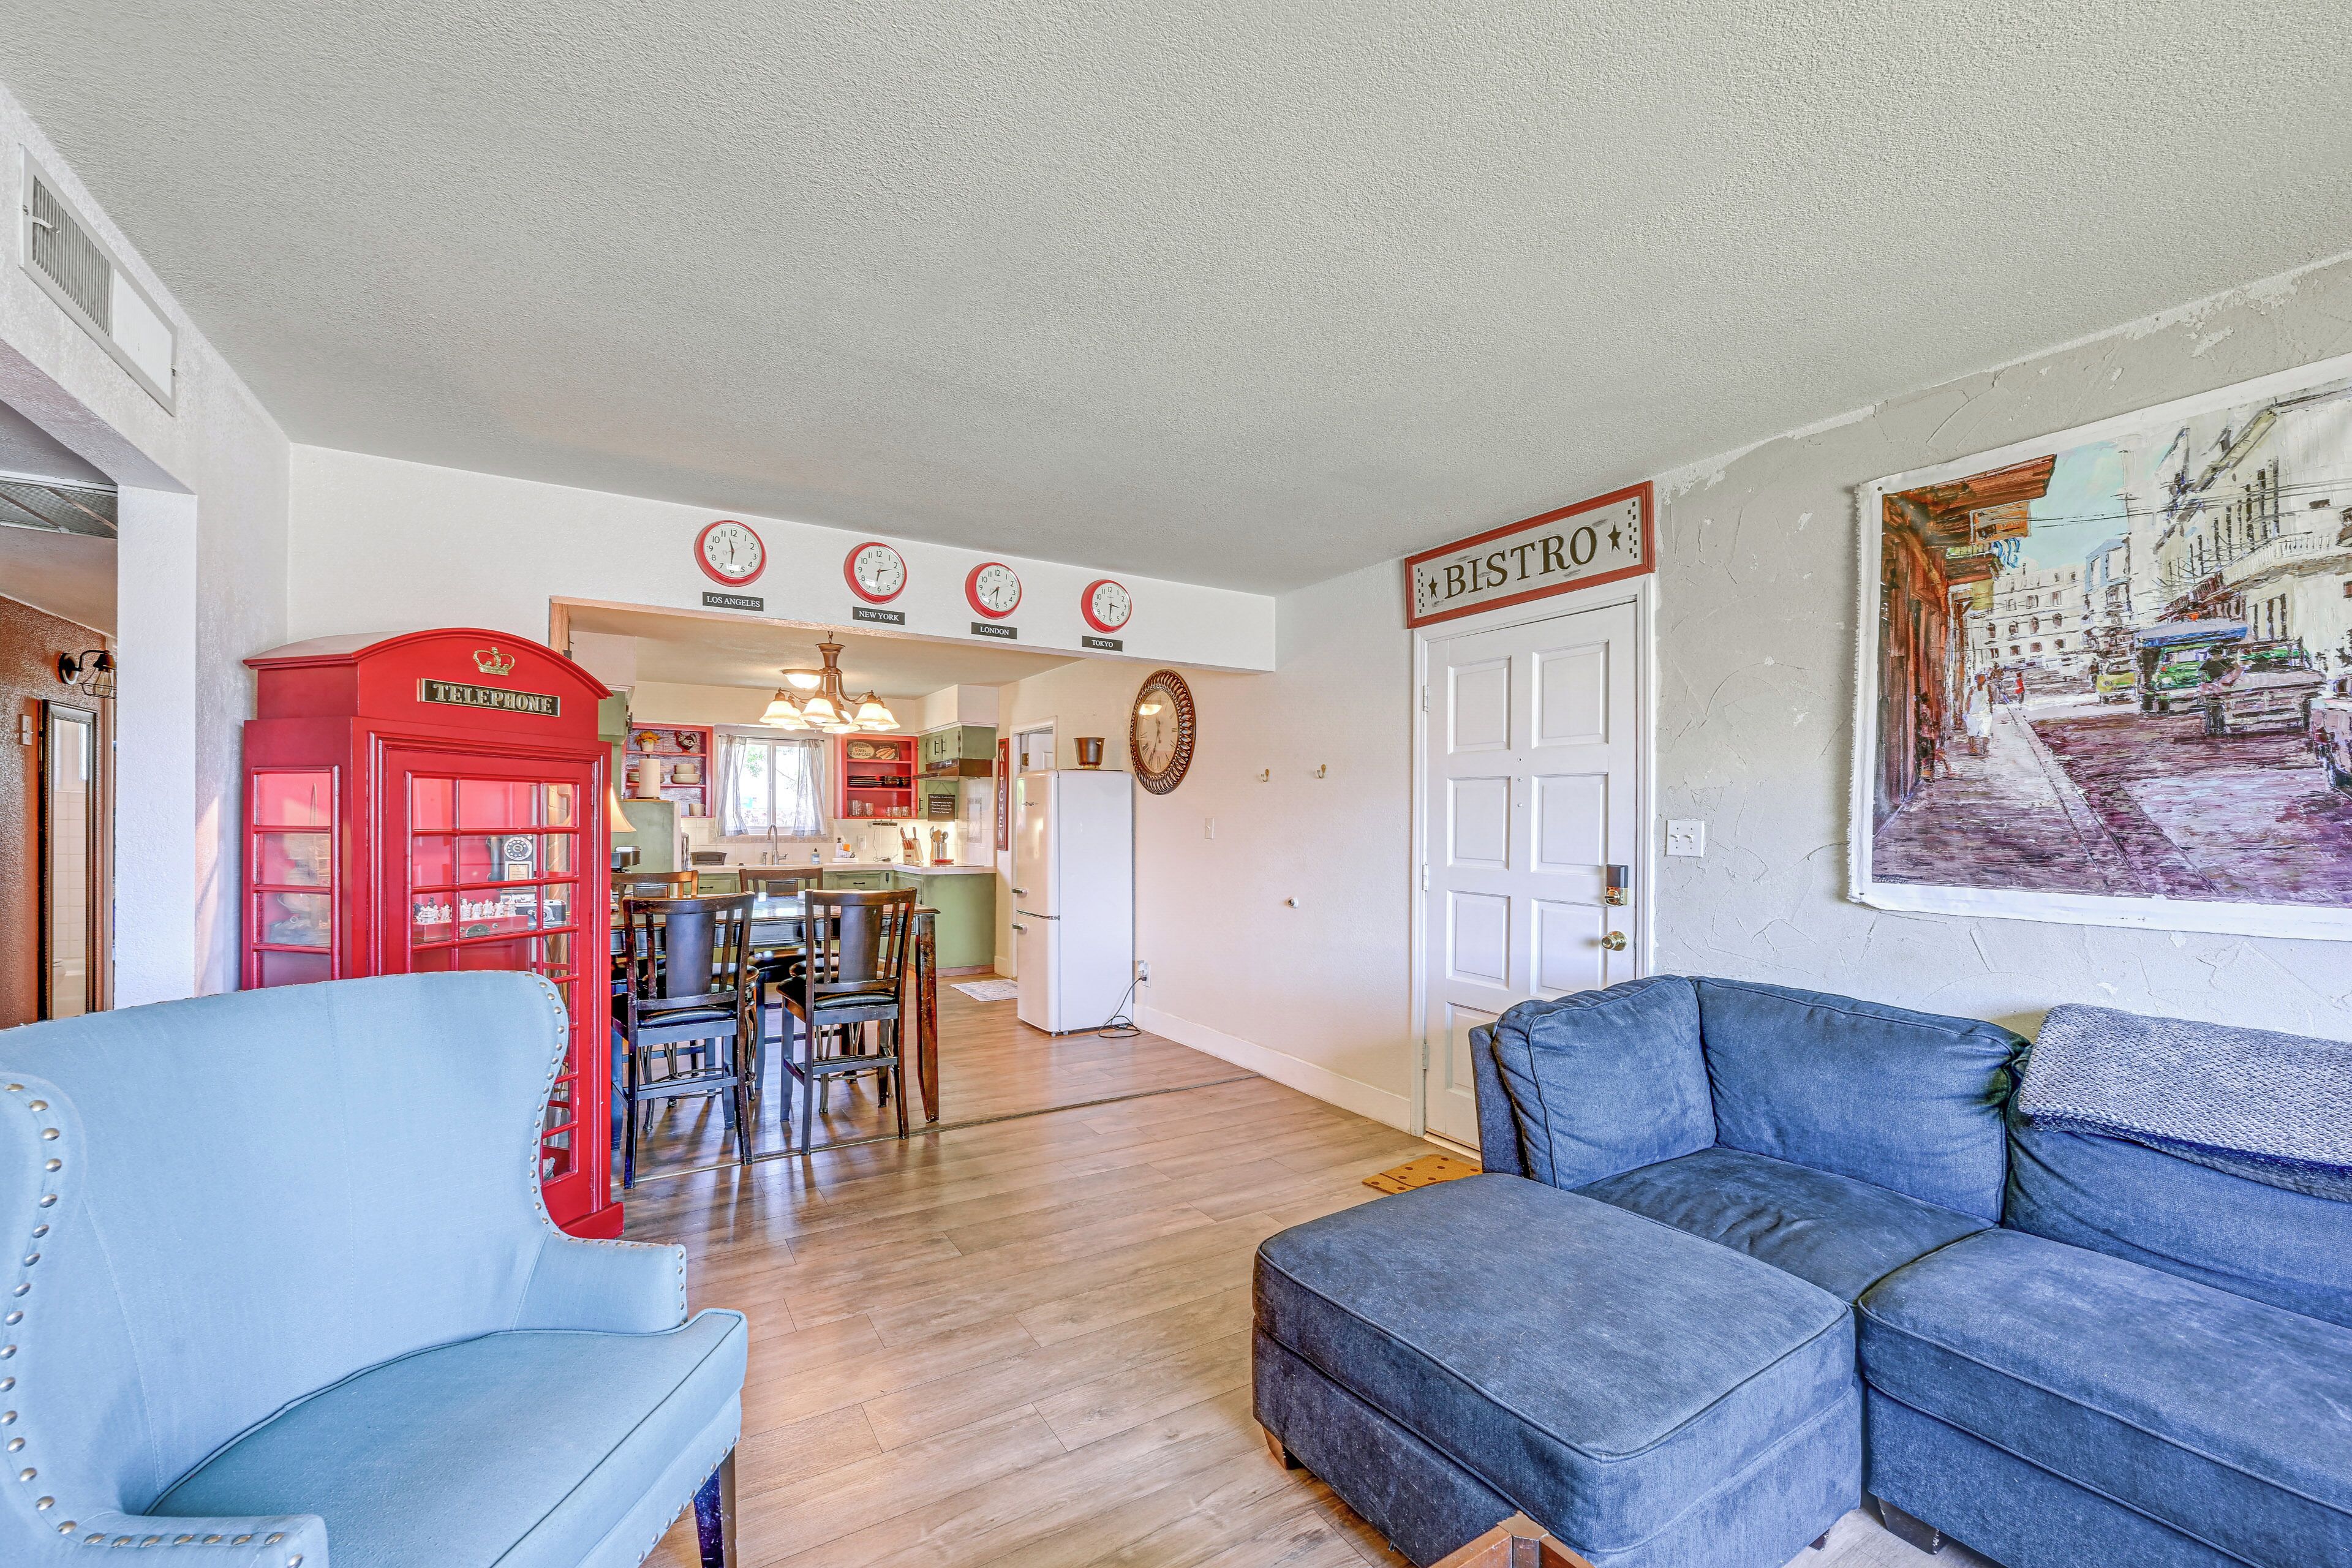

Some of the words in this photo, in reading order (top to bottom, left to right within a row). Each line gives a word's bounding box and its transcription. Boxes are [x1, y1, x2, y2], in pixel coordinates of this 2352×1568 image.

[1443, 525, 1598, 600] BISTRO
[706, 595, 723, 604] LOS
[723, 598, 761, 608] ANGELES
[980, 626, 1009, 635] LONDON
[432, 683, 552, 714] TELEPHONE
